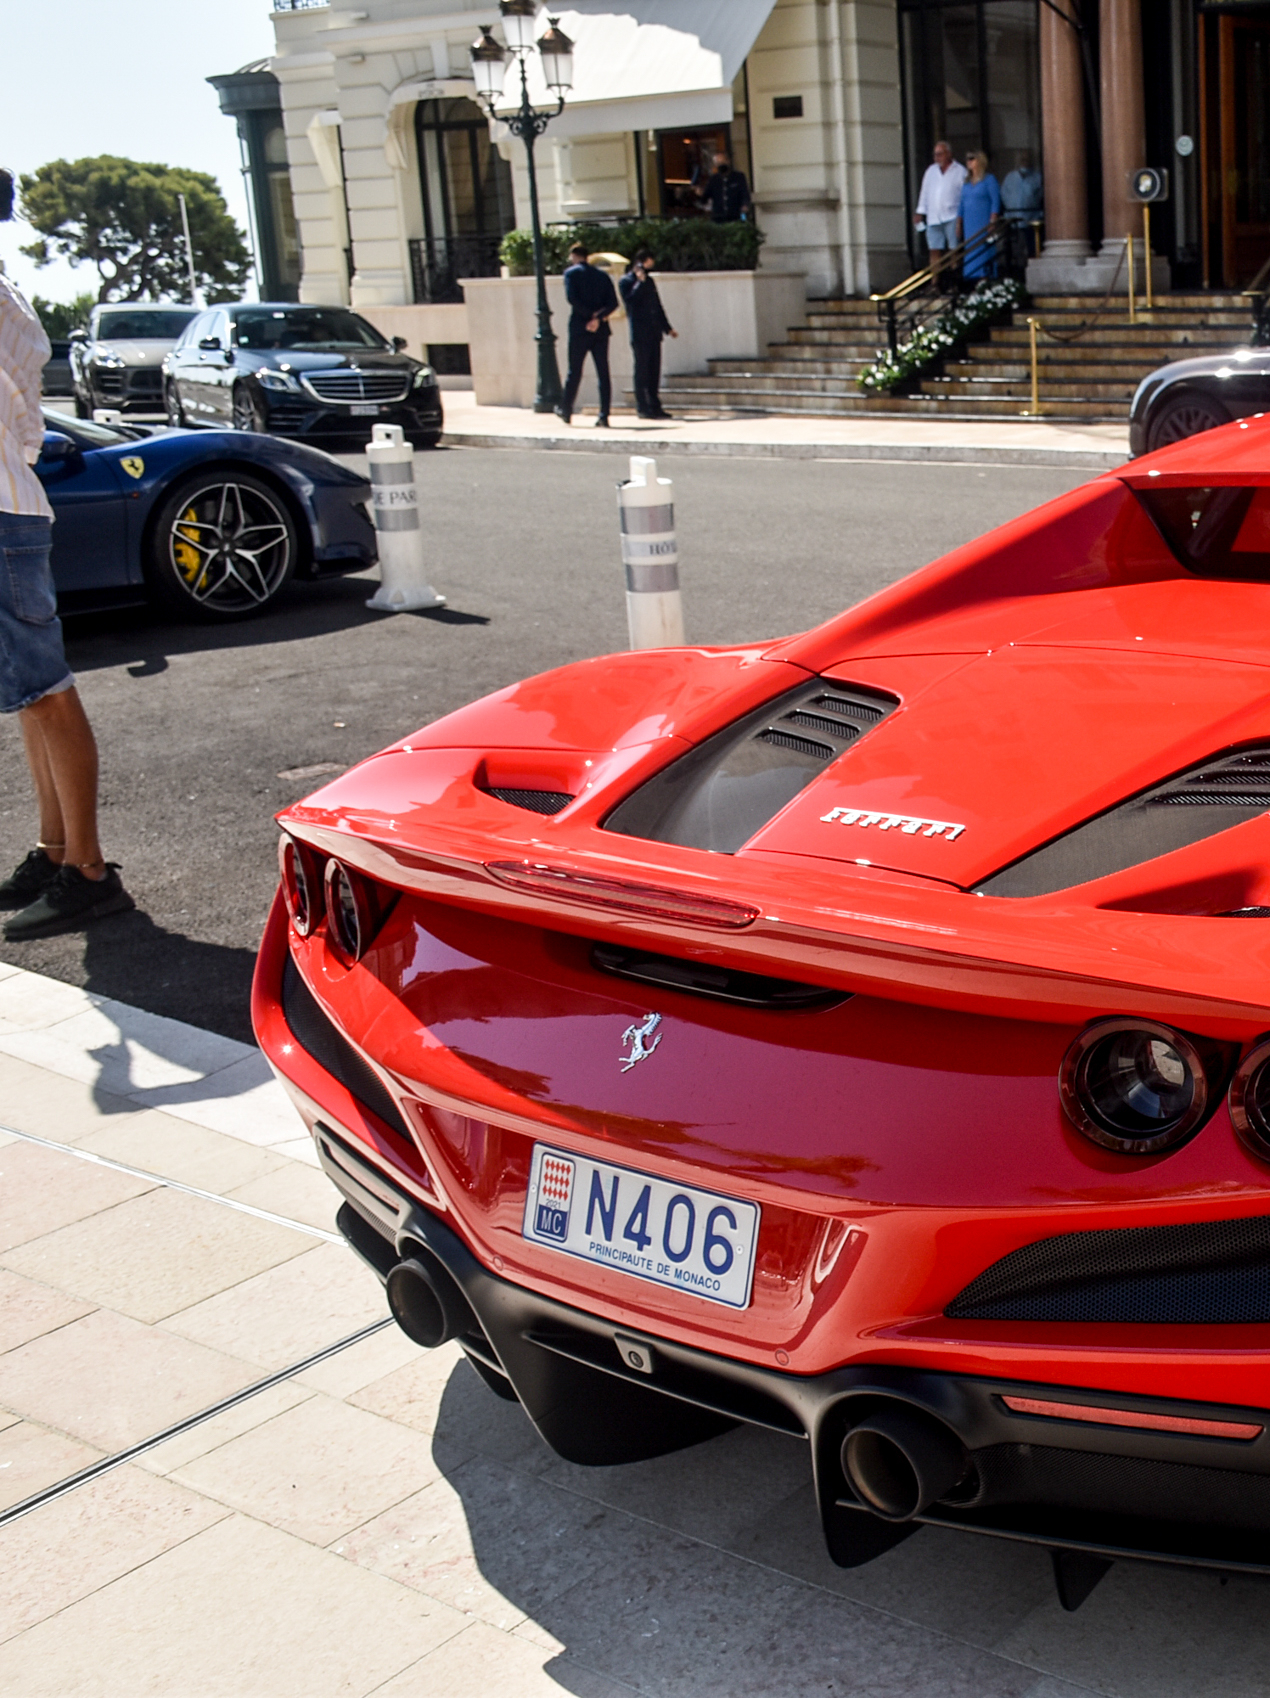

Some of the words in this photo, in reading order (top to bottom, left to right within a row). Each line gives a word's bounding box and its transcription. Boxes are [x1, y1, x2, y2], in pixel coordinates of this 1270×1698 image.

[819, 806, 966, 842] Ferrari
[545, 1198, 562, 1209] 2021
[540, 1210, 562, 1234] MC
[585, 1169, 738, 1276] N406
[588, 1241, 653, 1271] PRINCIPAUTE
[656, 1262, 670, 1277] DE
[674, 1266, 721, 1292] MONACO
